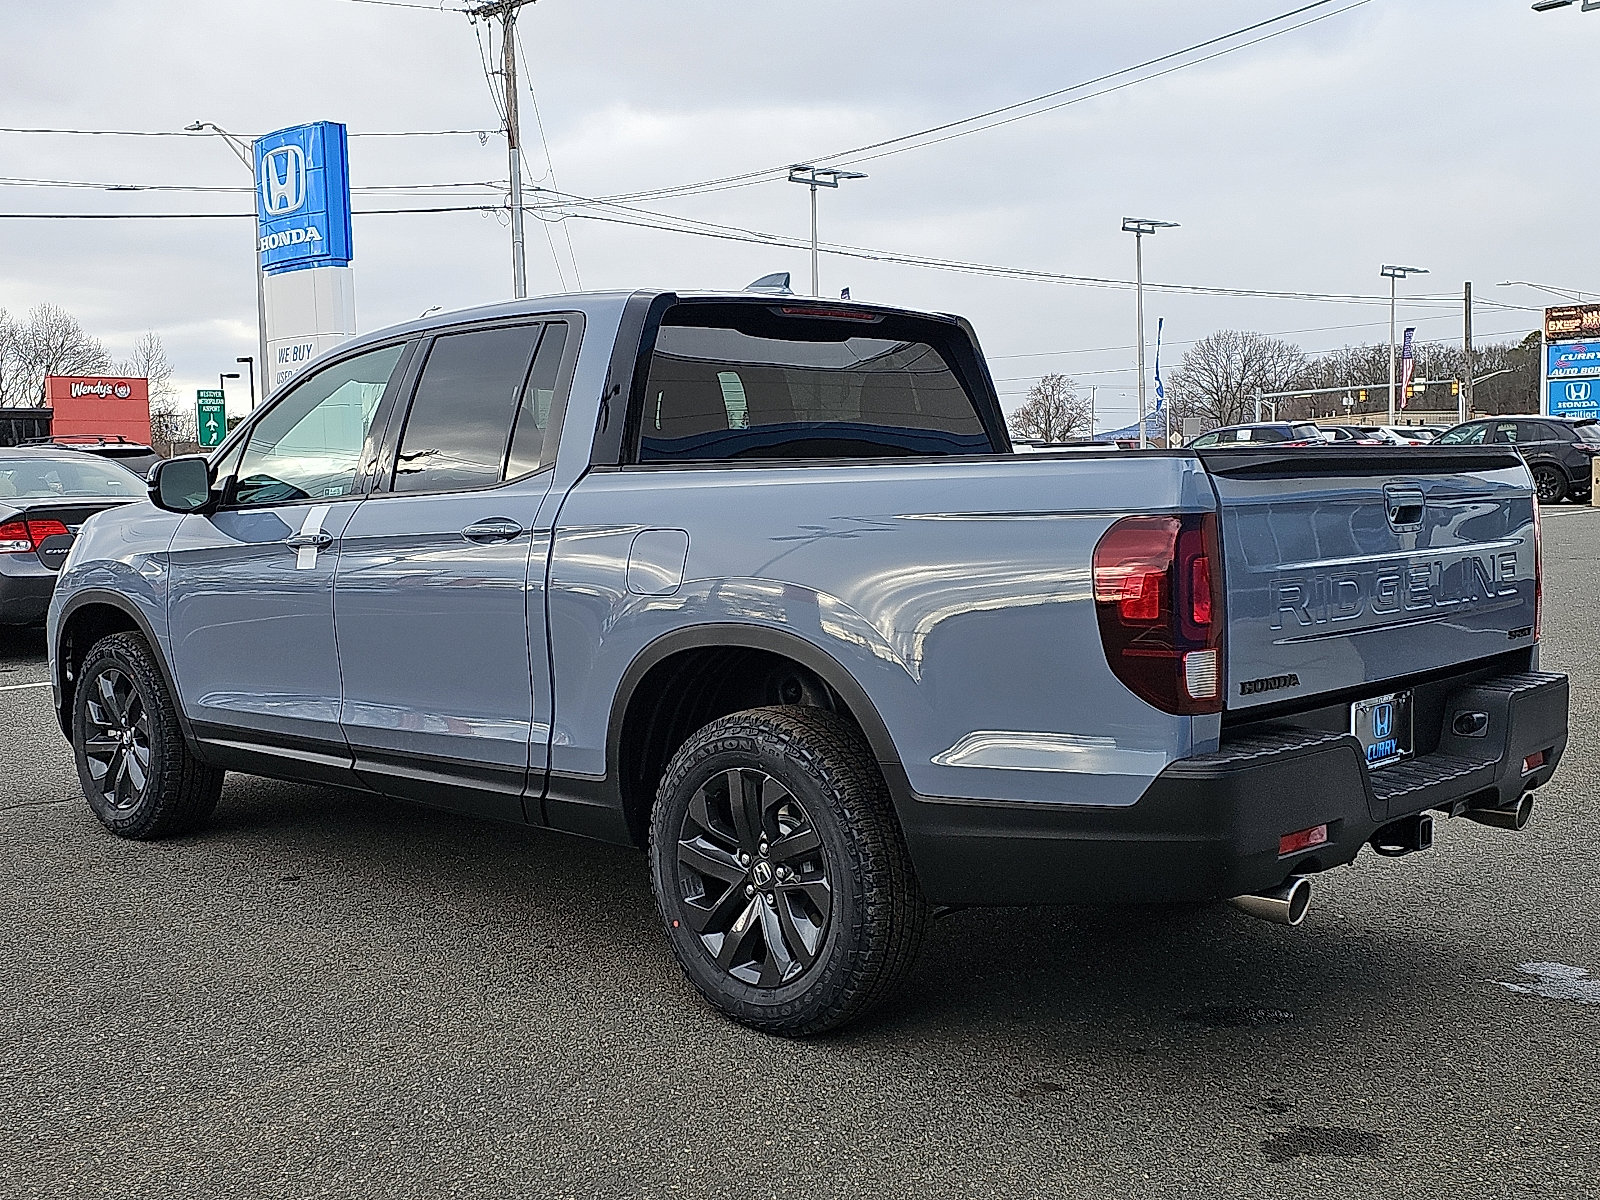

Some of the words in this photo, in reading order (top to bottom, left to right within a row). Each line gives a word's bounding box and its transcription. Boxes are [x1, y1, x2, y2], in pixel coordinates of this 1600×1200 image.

[259, 226, 323, 252] HONDA
[278, 347, 290, 364] WE
[292, 343, 312, 361] BUY
[1551, 367, 1579, 376] AUTO
[1580, 365, 1600, 375] BOD
[71, 380, 113, 398] Wendy's
[1557, 400, 1599, 409] HONDA
[1269, 551, 1519, 631] RIDGELINE
[1239, 673, 1301, 695] HONDA
[1367, 738, 1398, 761] CURRY
